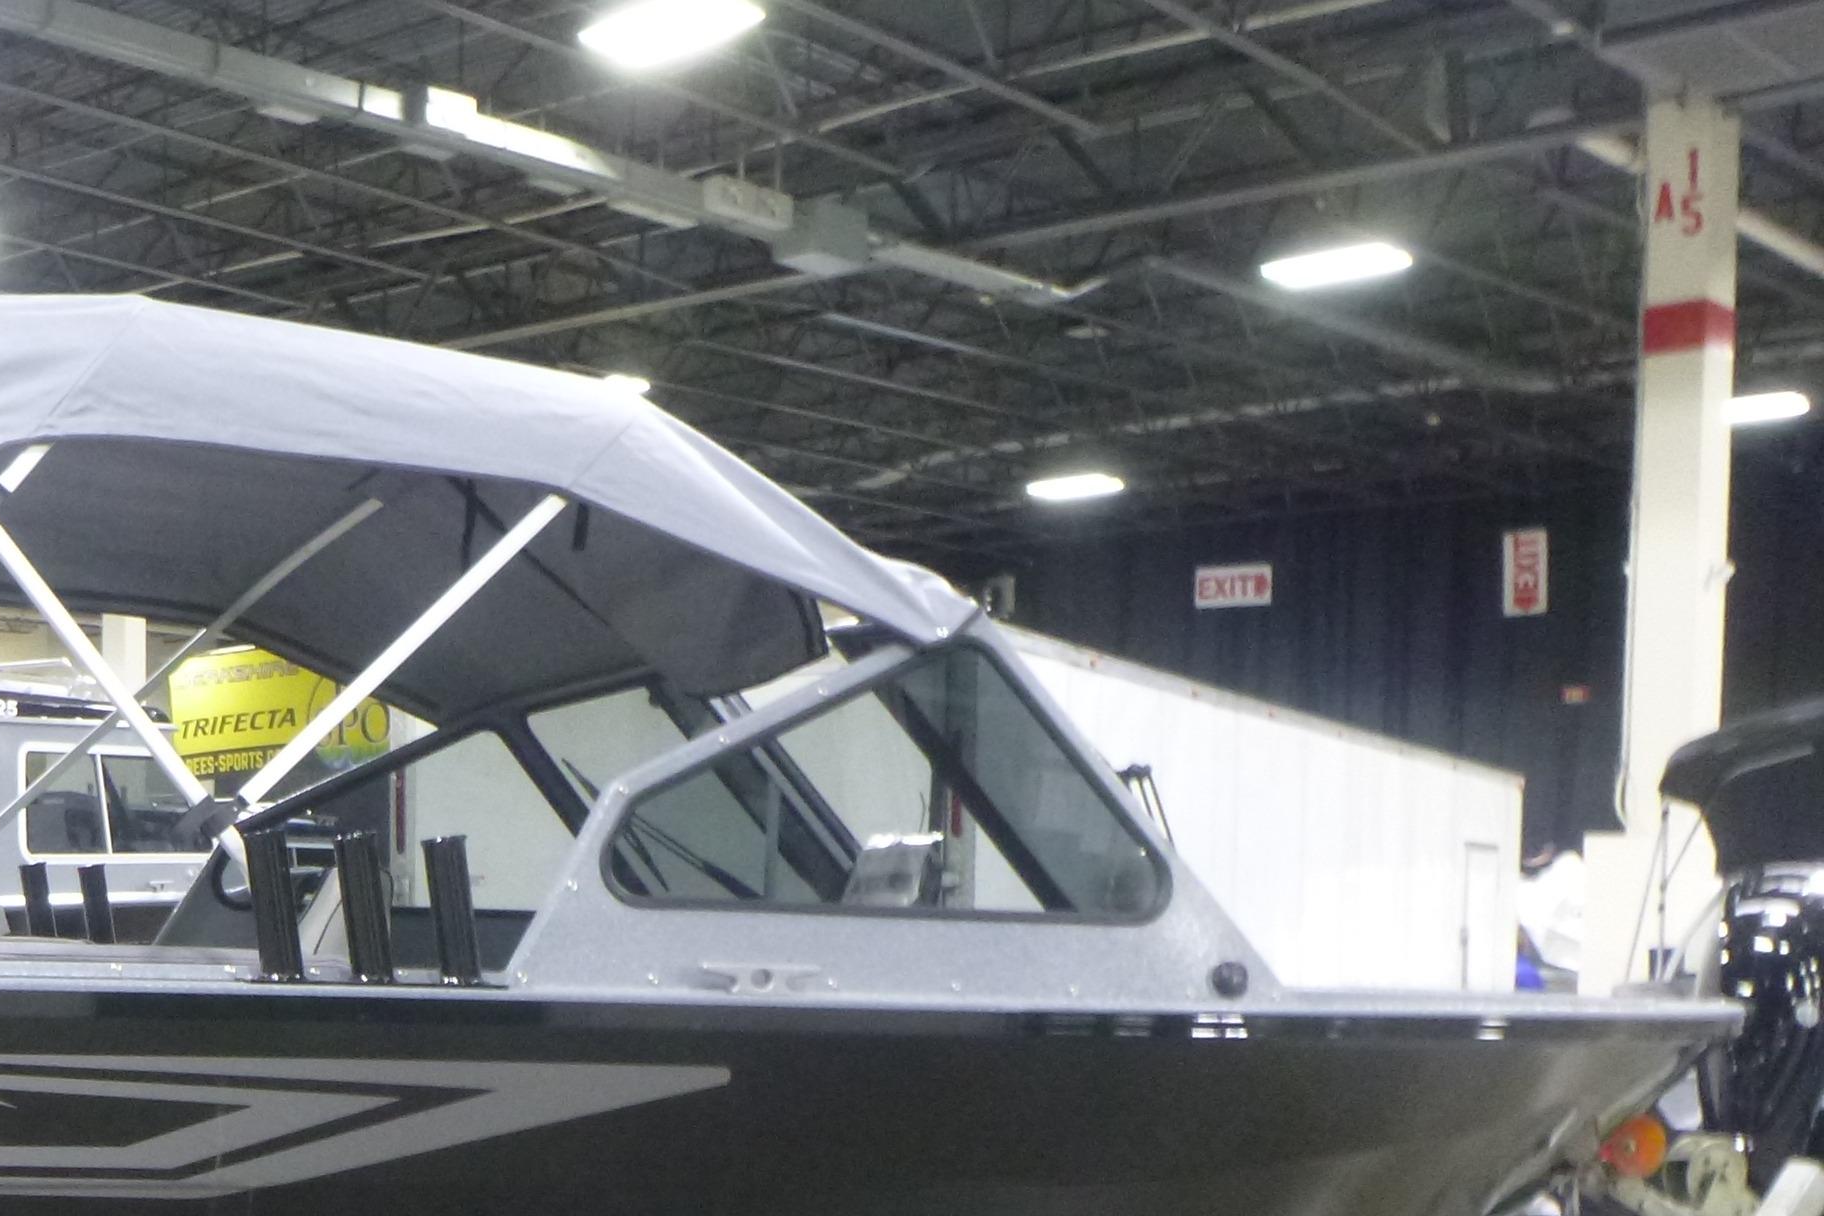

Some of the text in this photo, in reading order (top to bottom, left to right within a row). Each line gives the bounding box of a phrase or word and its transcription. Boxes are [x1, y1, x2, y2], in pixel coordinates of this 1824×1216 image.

[1653, 181, 1675, 223] A
[1514, 533, 1539, 590] EXIT
[1198, 574, 1250, 600] EXIT
[182, 708, 297, 740] TRIFECTA
